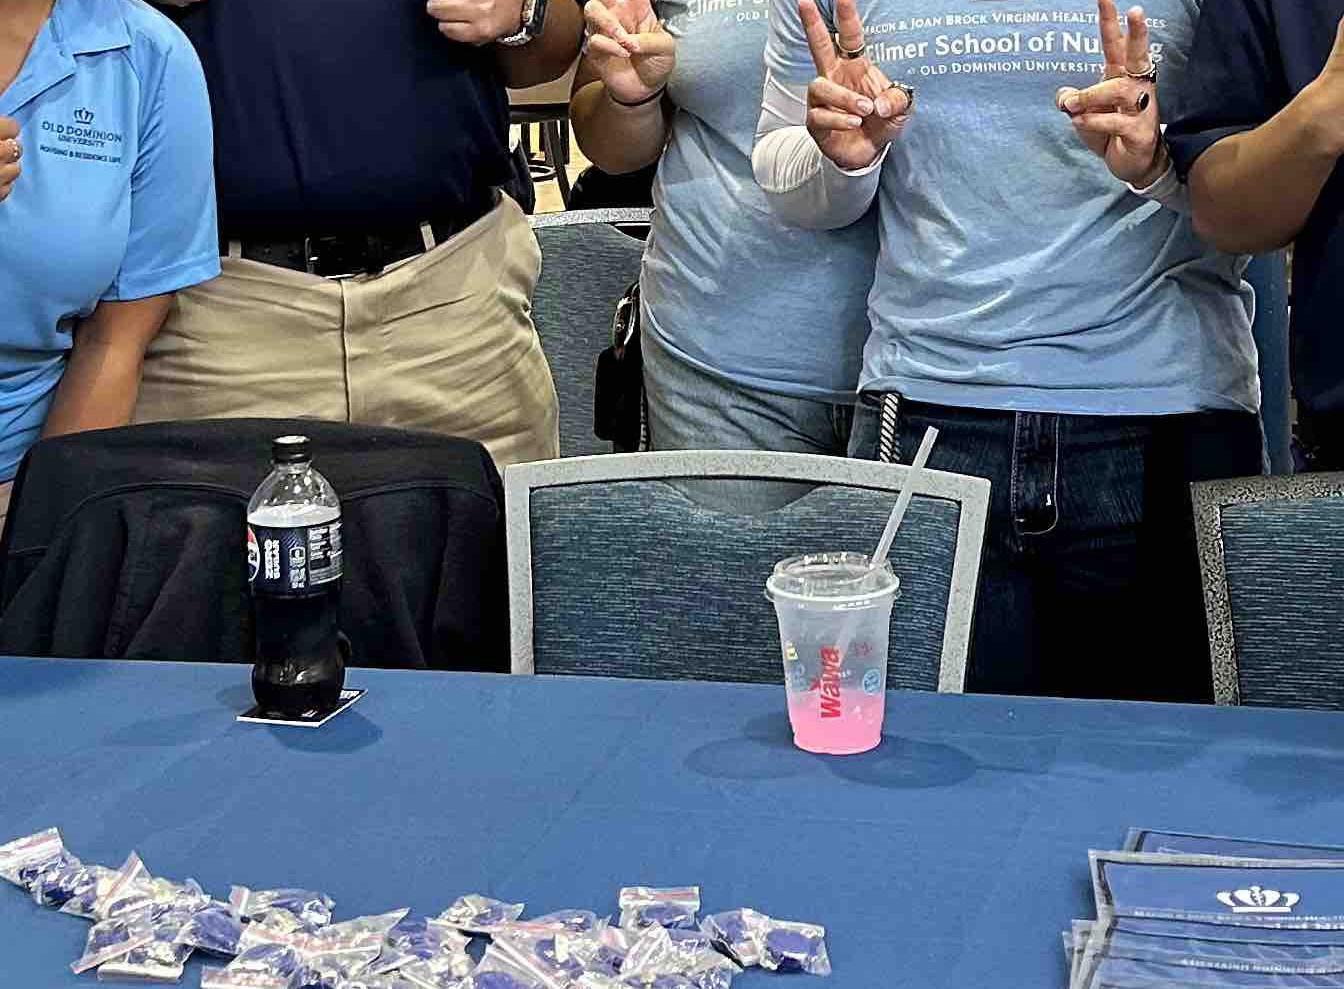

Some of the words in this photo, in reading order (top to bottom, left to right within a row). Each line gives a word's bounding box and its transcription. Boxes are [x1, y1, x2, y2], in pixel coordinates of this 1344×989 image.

[911, 17, 942, 29] JOAN
[946, 14, 988, 26] BROCK
[992, 11, 1049, 24] VIRGINIA
[936, 31, 1020, 55] School
[1028, 31, 1056, 52] of
[920, 63, 947, 75] OLD
[952, 61, 1021, 74] DOMINION
[1026, 59, 1104, 74] UNIVERSITY
[41, 121, 64, 133] OLD
[66, 125, 122, 143] DOMINION
[820, 645, 841, 718] Wawa
